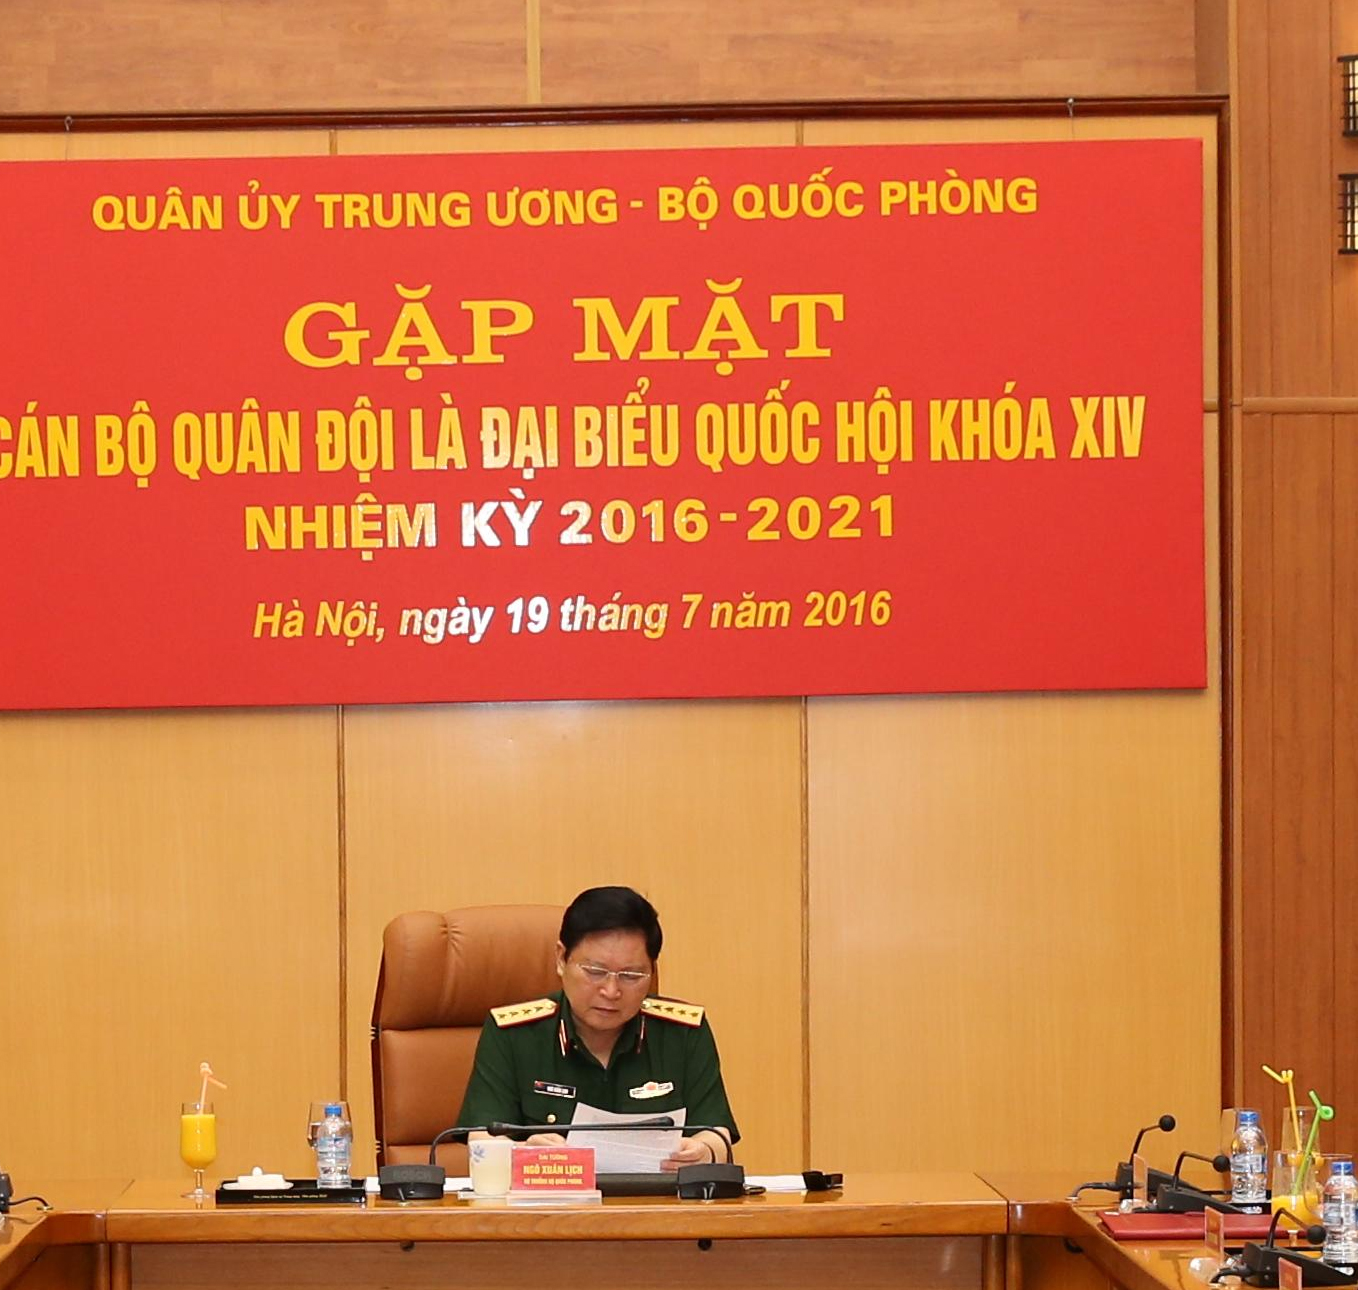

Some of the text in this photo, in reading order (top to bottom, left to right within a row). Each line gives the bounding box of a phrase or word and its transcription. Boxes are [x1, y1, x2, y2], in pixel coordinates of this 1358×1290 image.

[93, 187, 222, 230] QUÂN
[239, 180, 300, 229] ỦY
[315, 192, 470, 228] TRUNG
[487, 187, 617, 226] ƯƠNG
[659, 177, 718, 230] BỘ
[733, 167, 863, 219] QUỐC
[881, 169, 1036, 215] PHÒNG
[285, 278, 843, 380] GẶP MẶT
[96, 401, 156, 487] BỘ
[174, 398, 300, 479] QUÂN
[316, 396, 394, 482] ĐỘI
[411, 393, 467, 470] LÀ
[480, 406, 558, 481] ĐẠI
[574, 377, 679, 467] BIỂU
[696, 380, 819, 472] QUỐC
[837, 387, 912, 474] HỘI
[930, 382, 1055, 460] KHÓA
[1070, 396, 1145, 458] XIV
[246, 493, 436, 560] NHIỆM
[462, 488, 542, 546] KỲ
[254, 591, 891, 646] Hà Nội, ngày 19 tháng 7 năm 2016
